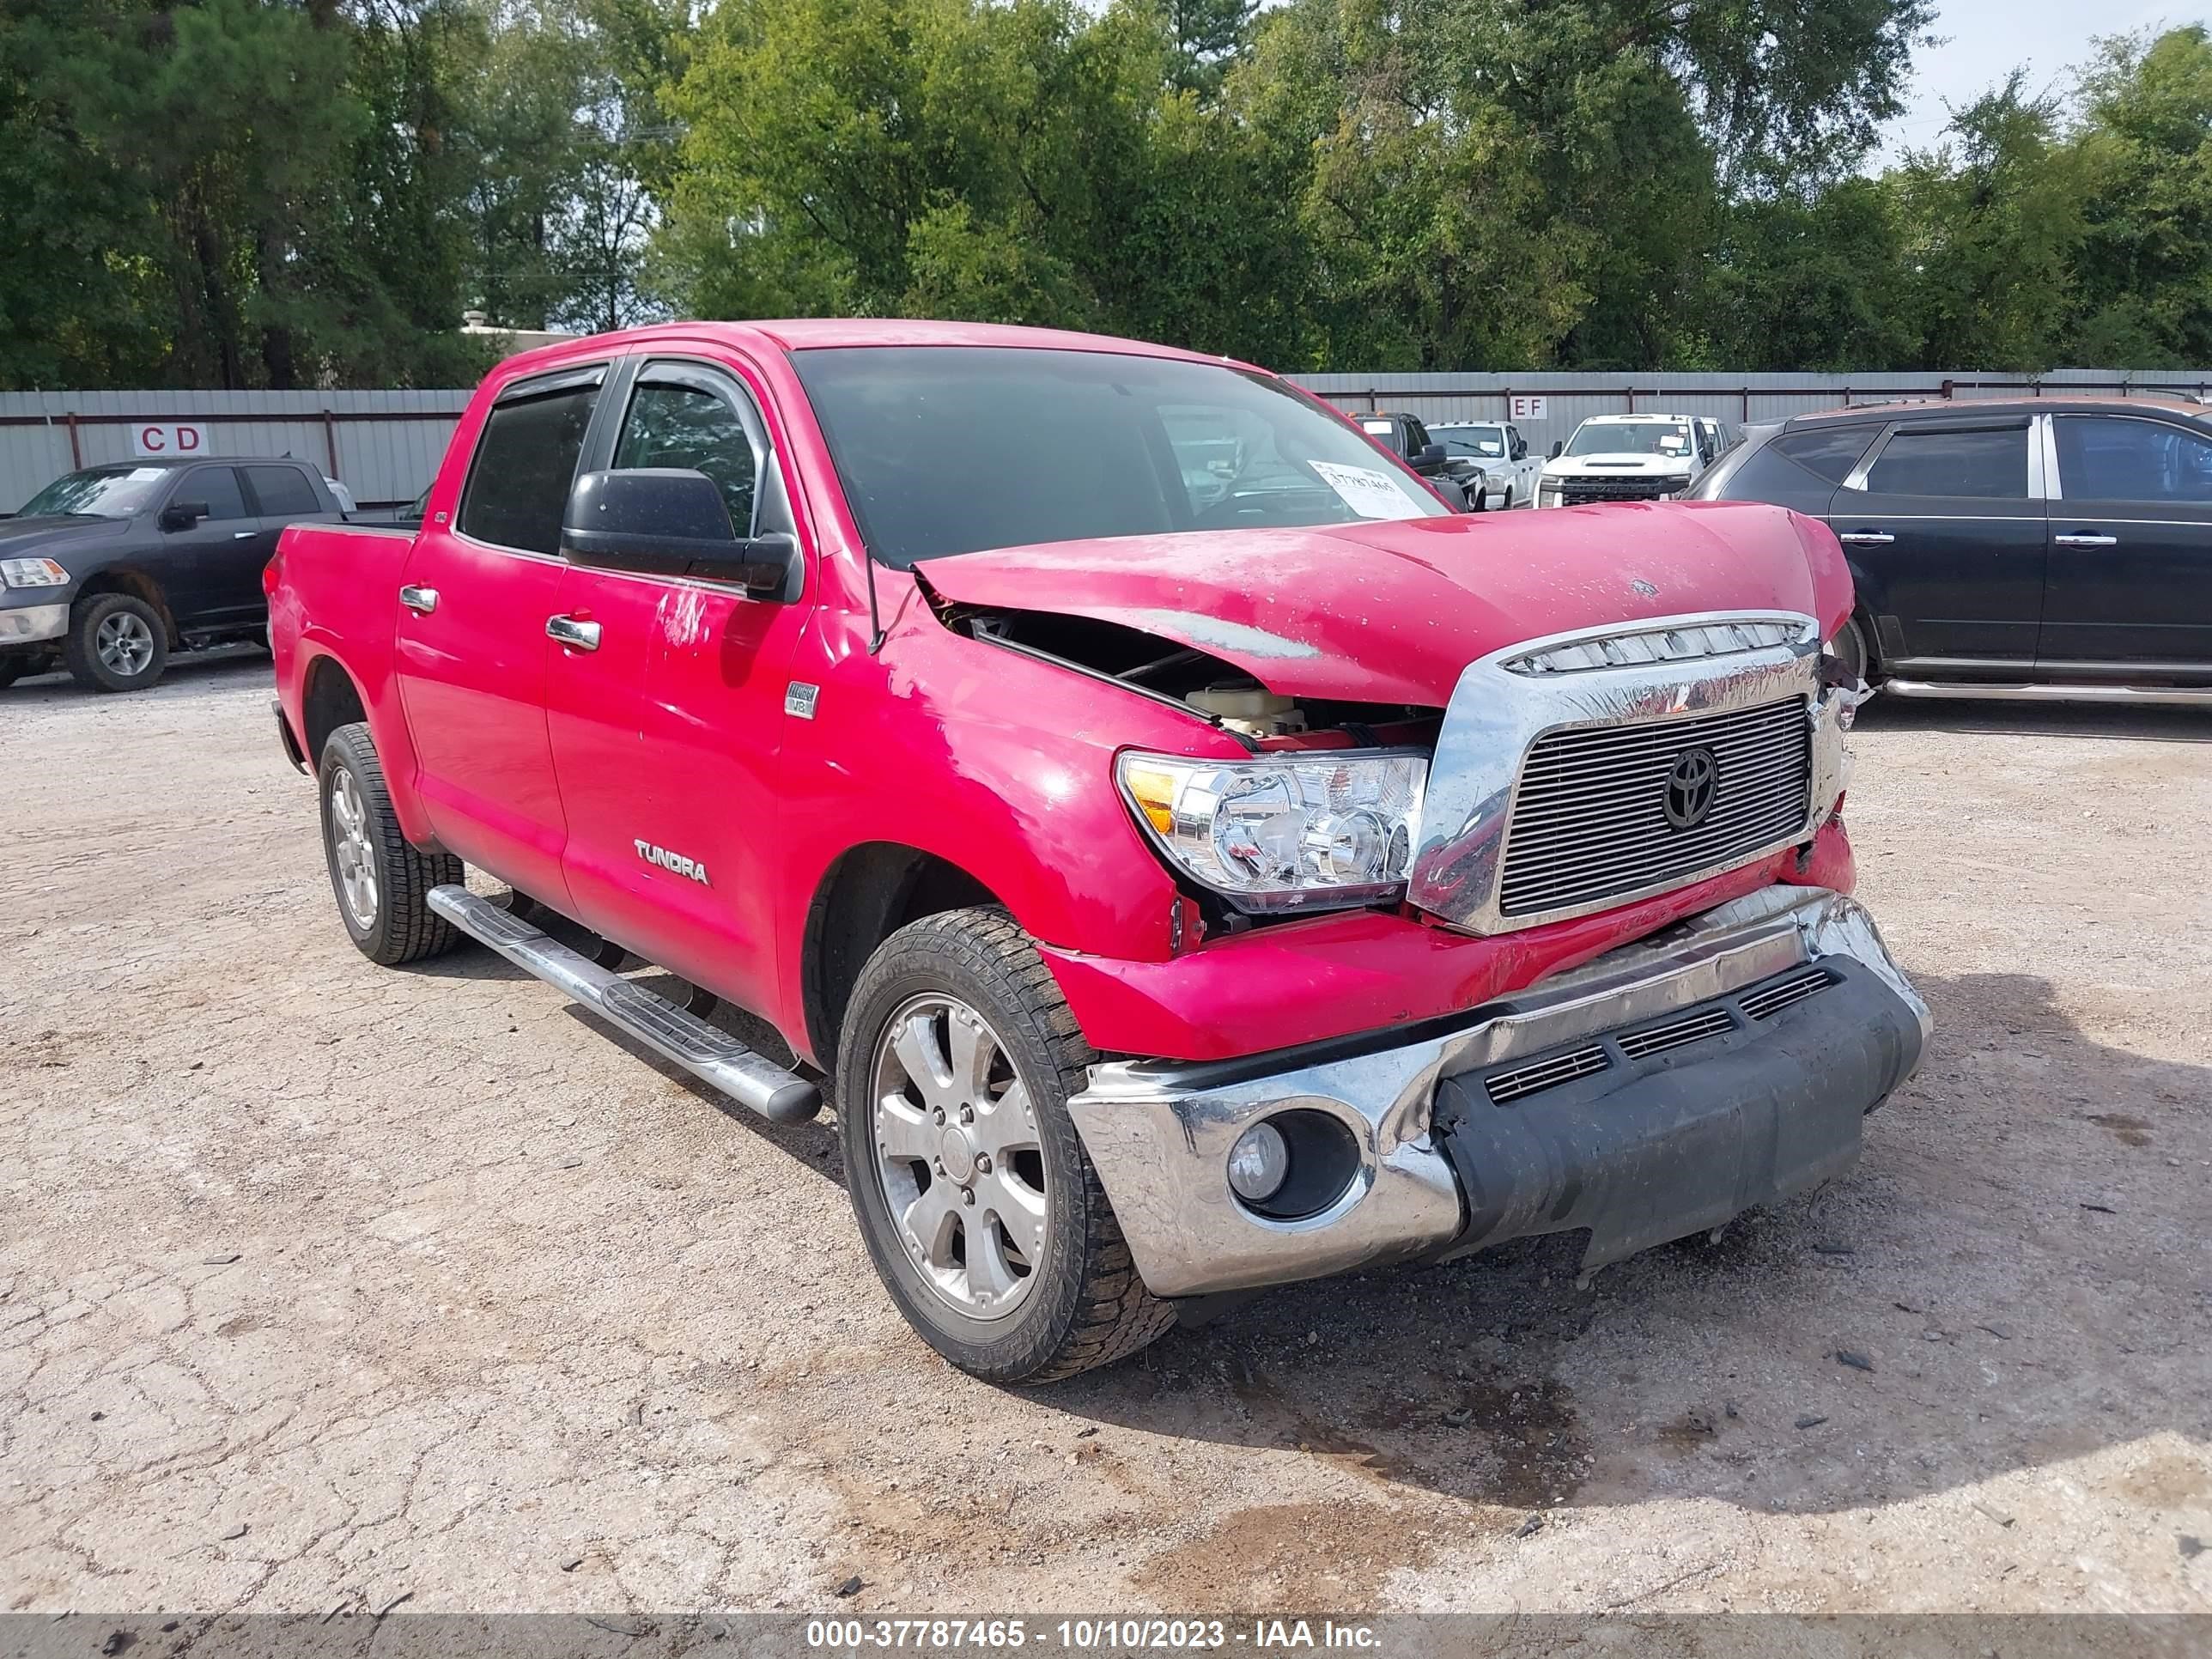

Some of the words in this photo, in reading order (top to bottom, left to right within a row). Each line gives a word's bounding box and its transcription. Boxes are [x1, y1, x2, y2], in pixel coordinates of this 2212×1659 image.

[1516, 399, 1525, 416] E
[1532, 399, 1540, 416] F
[142, 427, 165, 451] C
[177, 427, 199, 450] D
[792, 699, 805, 713] V8
[634, 838, 708, 885] TUNDRA
